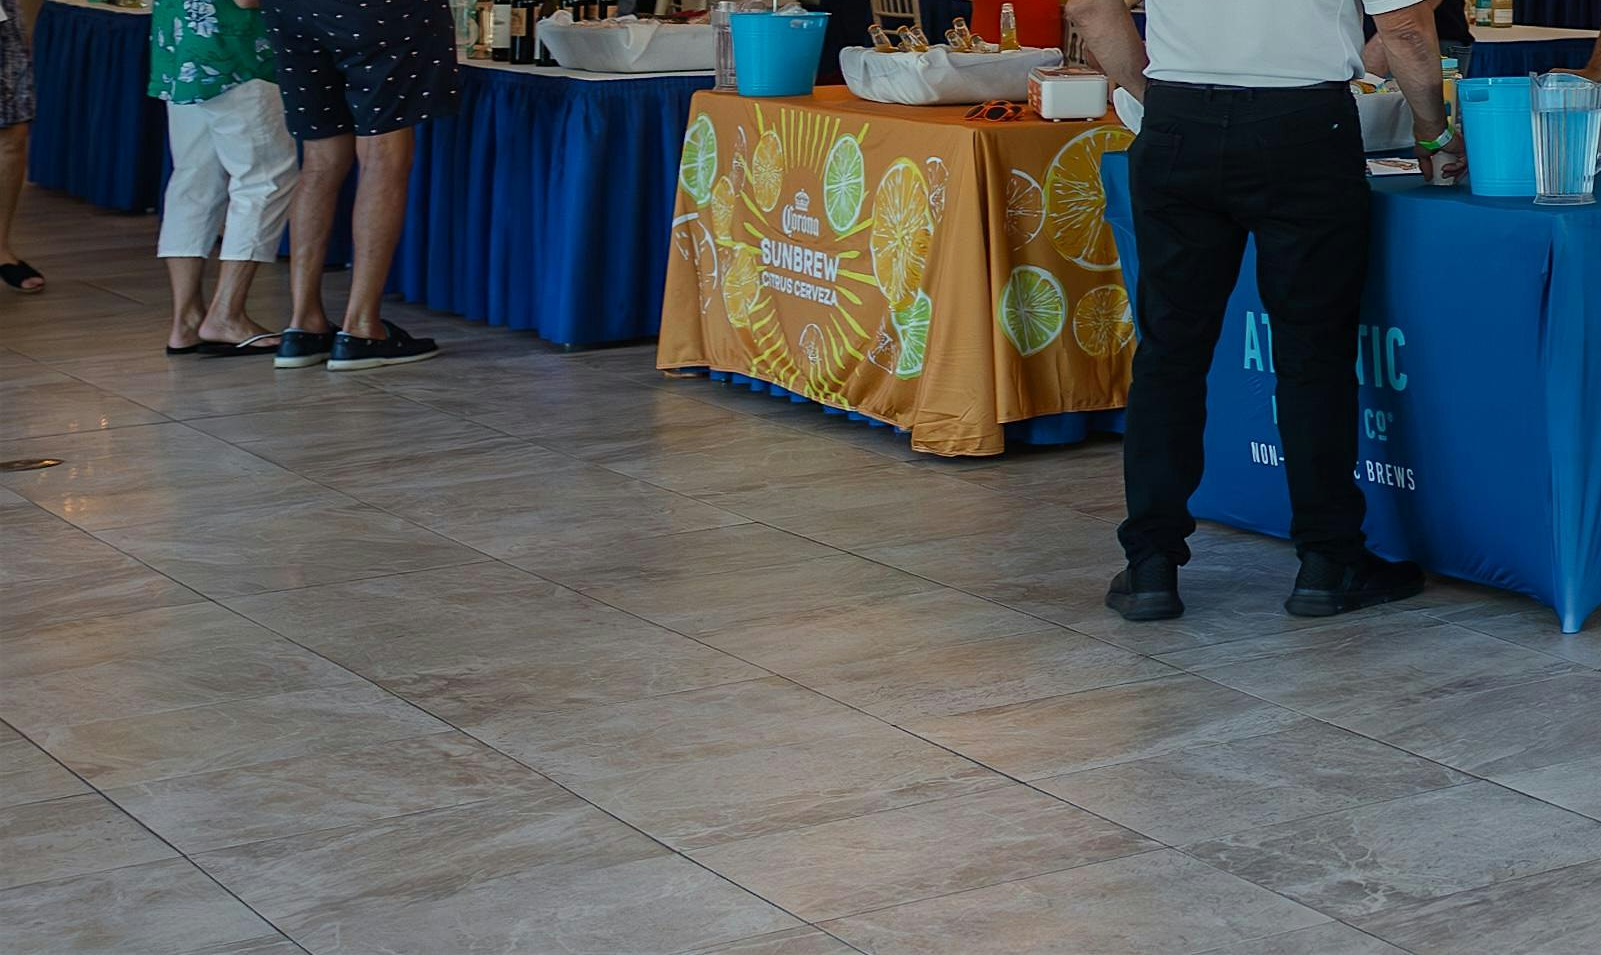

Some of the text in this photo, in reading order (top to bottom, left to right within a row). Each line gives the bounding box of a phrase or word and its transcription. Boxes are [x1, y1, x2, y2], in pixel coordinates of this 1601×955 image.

[782, 204, 820, 237] Corona
[761, 237, 840, 283] SUNBREW
[761, 271, 838, 306] CITRUS CERVEZA
[1366, 460, 1416, 491] BREWS
